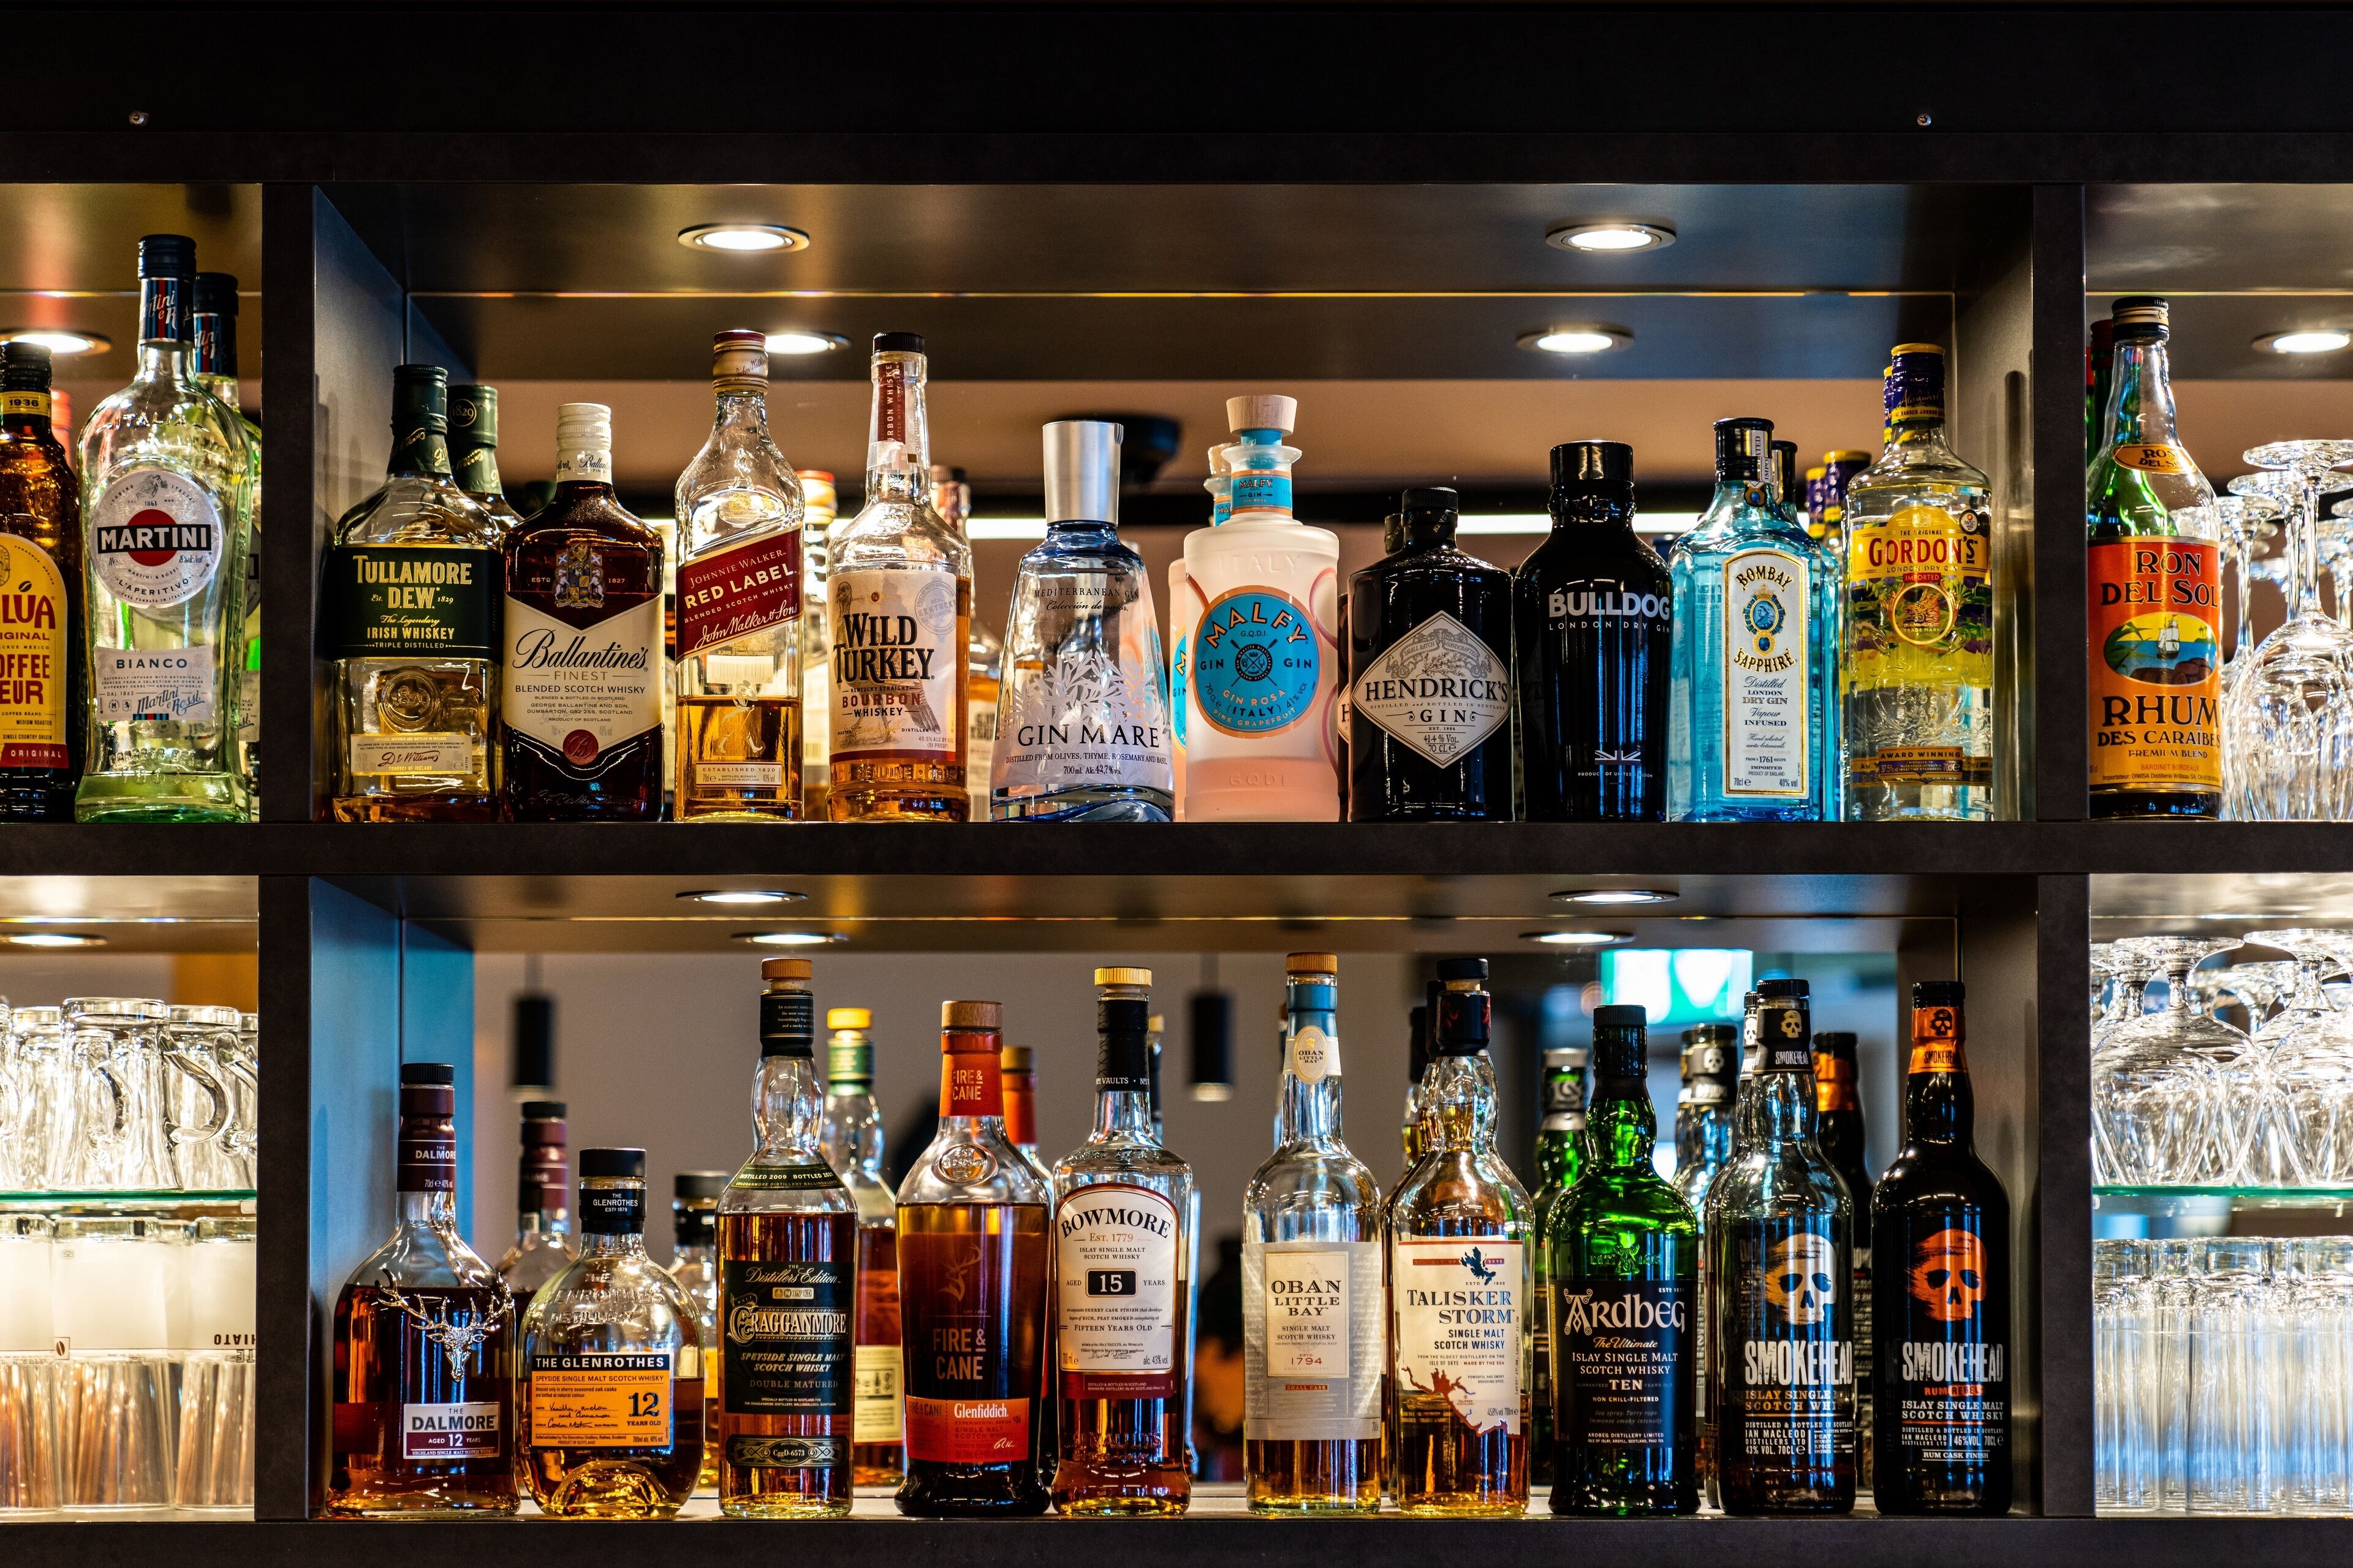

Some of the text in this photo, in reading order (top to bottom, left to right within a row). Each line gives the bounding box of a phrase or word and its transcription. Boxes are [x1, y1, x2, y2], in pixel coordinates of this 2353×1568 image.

[9, 399, 39, 407] 1936
[1239, 479, 1273, 488] MALFY
[101, 528, 207, 550] MARTINI
[1869, 536, 1978, 566] GORDON'S
[353, 556, 472, 585] TULLAMORE
[690, 550, 784, 587] JOHNNIE WALKER
[2135, 550, 2201, 575] RON
[118, 578, 189, 596] L'APERITIVO
[685, 562, 794, 608] RED LABEL
[1737, 566, 1793, 591] BOMBAY
[1035, 588, 1139, 599] MEDITERRANEAN GIN
[2101, 580, 2217, 608] DEL SOL
[684, 583, 794, 623] BLENDED SCOTCH WHISKY
[1047, 600, 1088, 611] Colección
[1091, 600, 1102, 610] de
[1549, 592, 1670, 620] BULLDOG
[399, 616, 440, 627] Legendary
[844, 613, 918, 647] WILD
[1205, 602, 1307, 648] MALFY
[1656, 624, 1670, 633] GIN
[368, 627, 454, 640] IRISH WHISKEY
[513, 629, 648, 668] Ballantine's
[116, 659, 187, 668] BIANCO
[833, 643, 934, 683] TURKEY
[1200, 659, 1224, 670] GIN
[1283, 658, 1311, 669] GIN
[1733, 646, 1795, 673] SAPPHIRE
[554, 672, 608, 681] FINEST
[1743, 676, 1786, 690] Distilled
[1223, 689, 1286, 706] GIN ROSA
[1365, 679, 1508, 702] HENDRICK'S
[137, 687, 179, 714] Martini
[172, 691, 205, 715] Rossi
[842, 693, 920, 708] BOURBON
[854, 707, 903, 717] WHISKEY
[1213, 707, 1297, 727] PINK GRAPEFRUIT
[1420, 710, 1466, 722] GIN
[1750, 707, 1781, 719] Vapour
[2102, 695, 2219, 727] RHUM
[1018, 724, 1159, 748] GIN MARE
[2097, 727, 2221, 748] DES CARAÏBES
[2182, 749, 2207, 758] BLEND
[1061, 1208, 1170, 1240] BOWMORE
[1090, 1233, 1133, 1243] Est. 1779
[745, 1267, 838, 1283] Distillers Edition
[1101, 1275, 1123, 1292] 15
[1271, 1280, 1341, 1293] OBAN
[1275, 1297, 1339, 1306] LITTLE
[1407, 1289, 1512, 1306] TALISKER
[1288, 1307, 1324, 1316] BAY
[1439, 1308, 1512, 1324] STORM
[728, 1307, 847, 1343] CRAGGANMORE
[933, 1328, 986, 1352] FIRE &
[1434, 1341, 1505, 1349] SCOTCH WHISKY
[1594, 1338, 1658, 1348] The Ultimate
[536, 1357, 664, 1368] THE GLENROTHES
[1572, 1352, 1677, 1362] ISLAY SINGLE MALT
[1745, 1341, 1852, 1385] SMOKEHEAD
[1903, 1342, 2003, 1382] SMOKEHEAD
[754, 1363, 794, 1372] SCOTCH
[937, 1356, 983, 1380] CANE
[1580, 1366, 1670, 1374] SCOTCH WHISKY
[1609, 1380, 1642, 1390] TEN
[629, 1392, 659, 1417] 12
[954, 1403, 1007, 1418] Glenfiddich
[412, 1413, 494, 1431] DALMORE
[449, 1434, 463, 1446] 12
